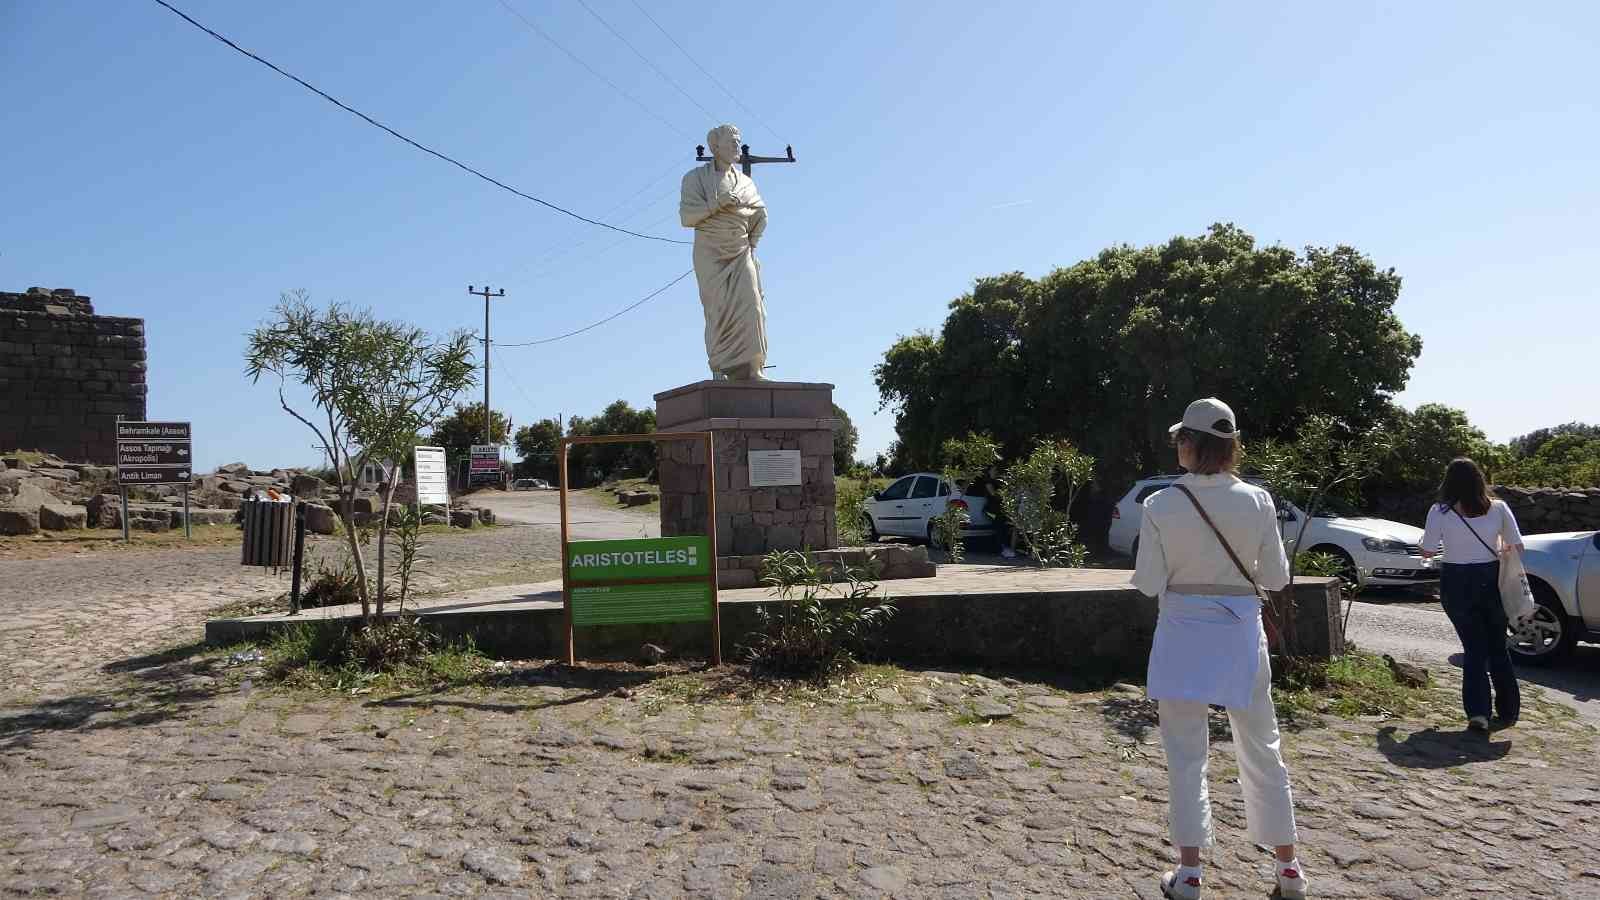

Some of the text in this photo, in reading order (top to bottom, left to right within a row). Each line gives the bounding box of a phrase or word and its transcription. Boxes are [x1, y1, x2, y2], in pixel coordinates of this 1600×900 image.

[120, 444, 142, 452] Assos
[141, 472, 163, 480] Liman
[571, 549, 688, 568] ARISTOTELES
